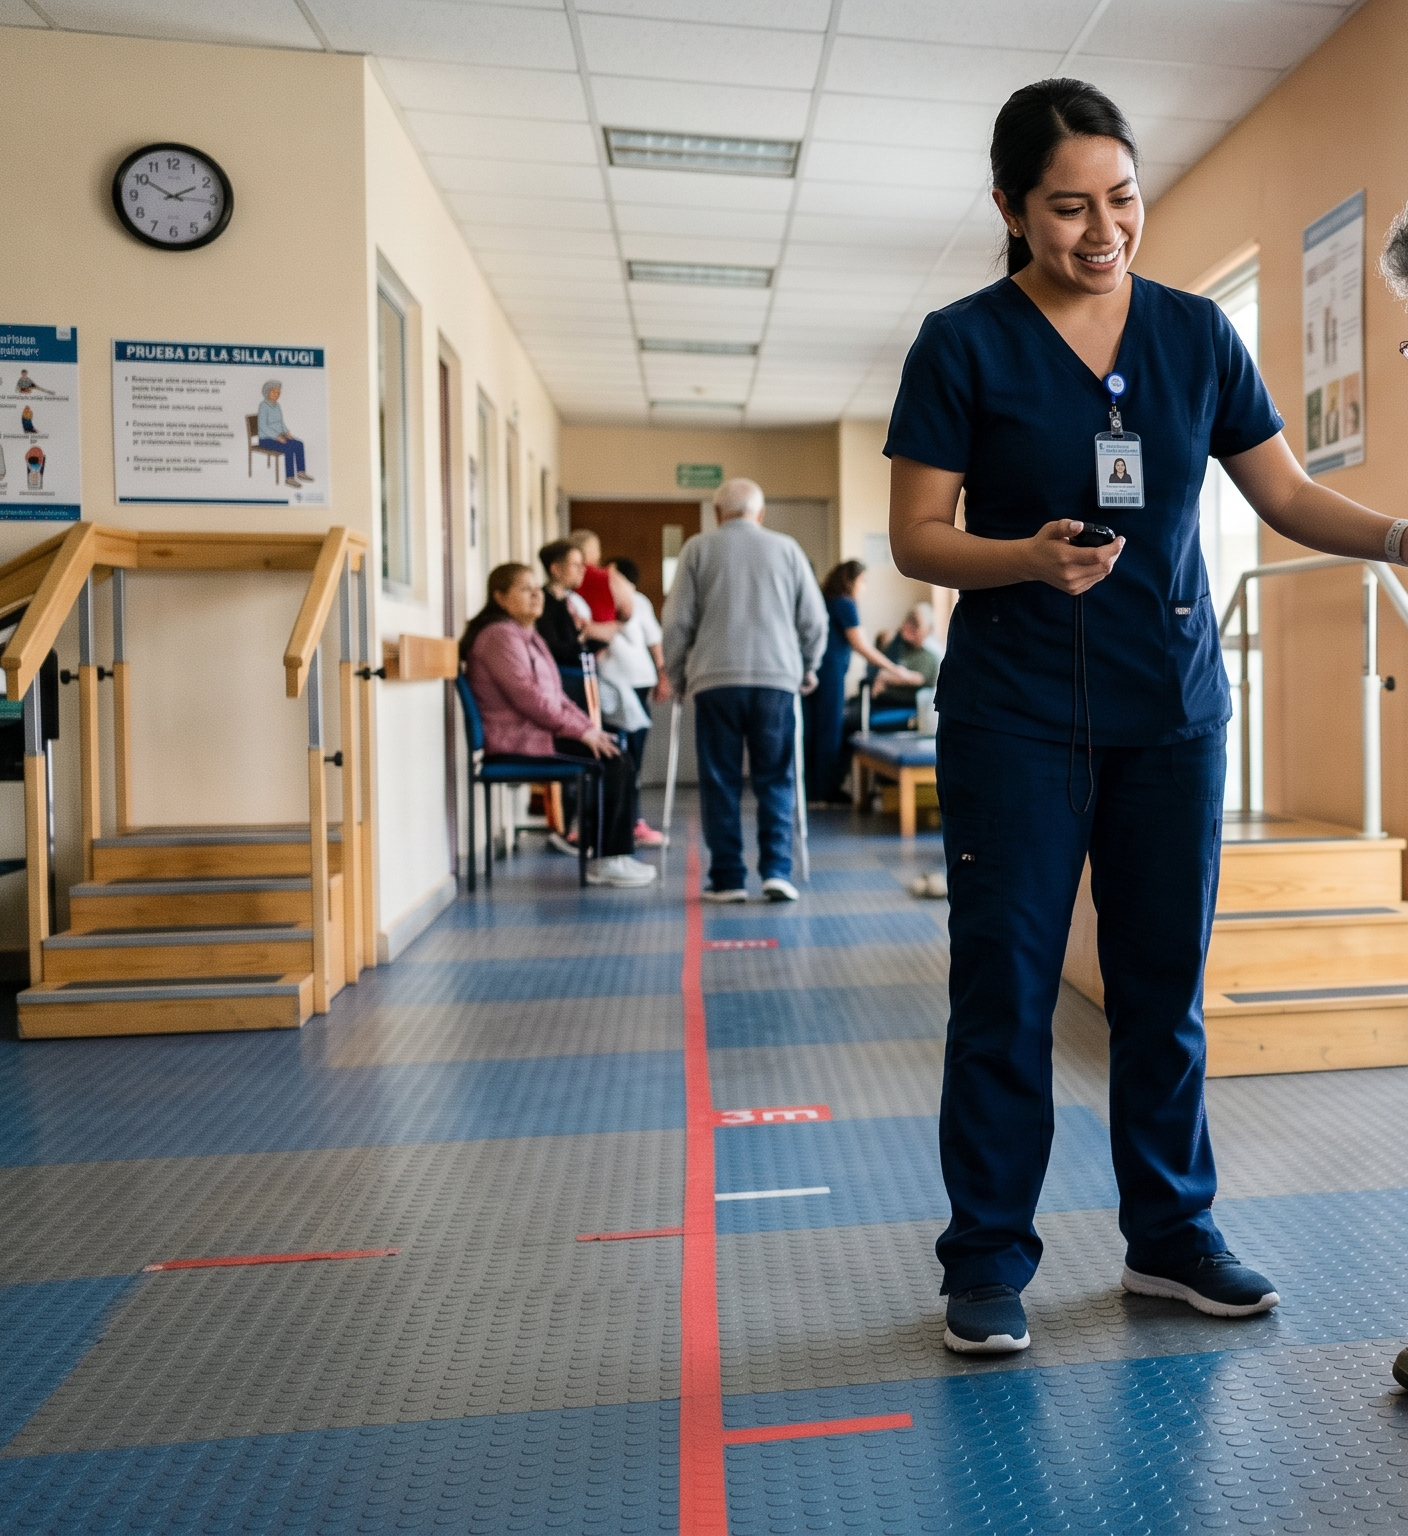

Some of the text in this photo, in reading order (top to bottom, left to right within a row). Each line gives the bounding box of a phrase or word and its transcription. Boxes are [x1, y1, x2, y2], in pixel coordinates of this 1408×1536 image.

[148, 161, 159, 173] 11
[166, 158, 180, 170] 12
[191, 163, 196, 175] 1
[134, 173, 149, 186] 10
[202, 176, 211, 189] 2
[129, 189, 139, 202] 9
[209, 193, 219, 206] 3
[135, 206, 145, 219] 8
[203, 210, 212, 222] 4
[151, 220, 158, 233] 7
[169, 226, 179, 238] 6
[190, 222, 199, 234] 5
[126, 344, 185, 360] PRUEBA
[187, 346, 207, 361] DE
[210, 348, 229, 362] LA
[232, 348, 272, 364] SILLA
